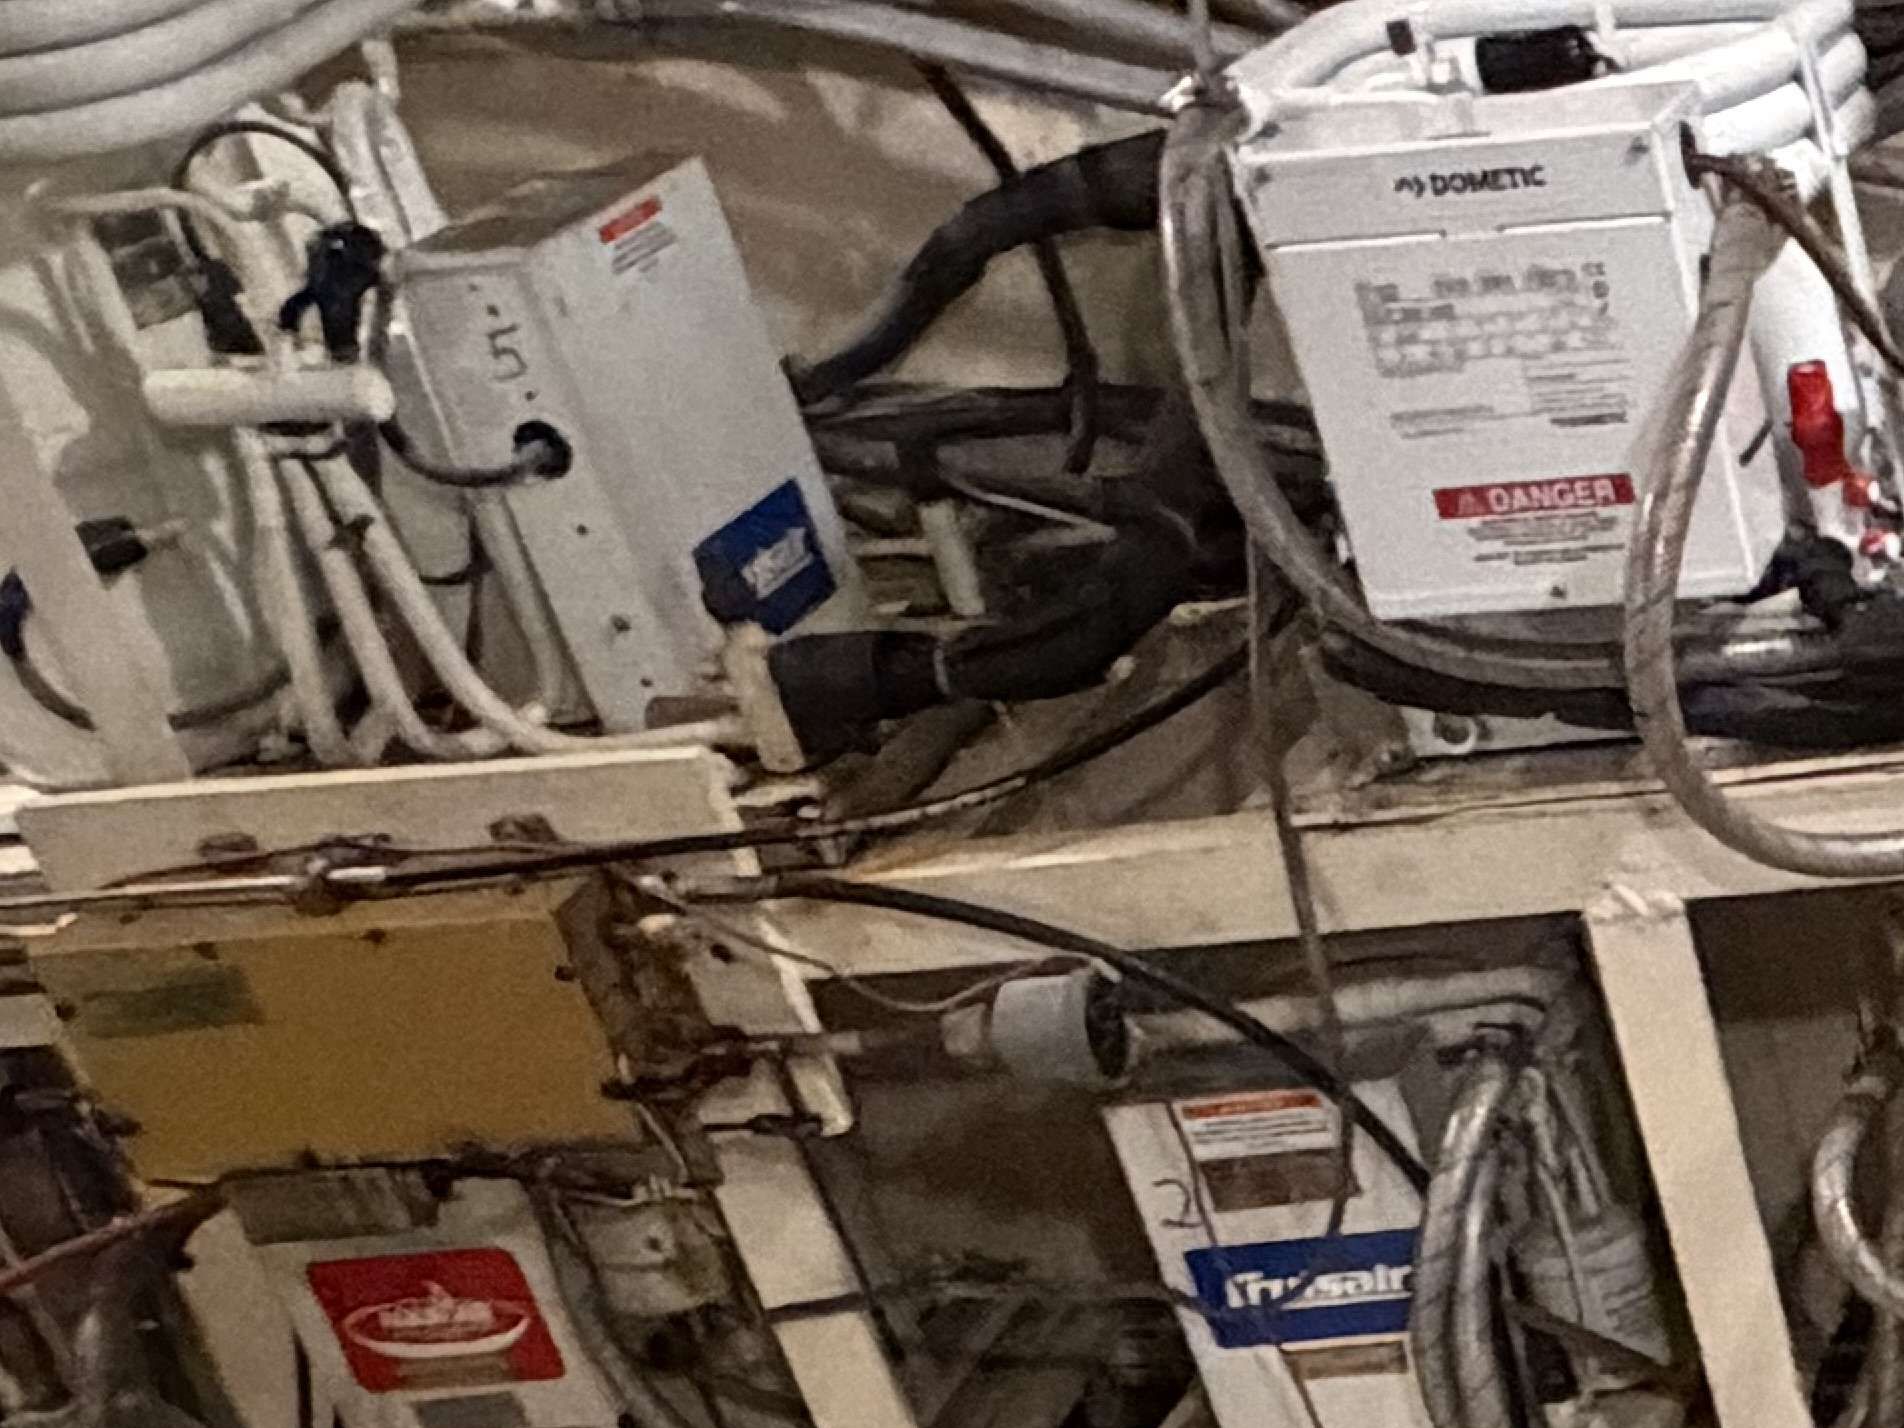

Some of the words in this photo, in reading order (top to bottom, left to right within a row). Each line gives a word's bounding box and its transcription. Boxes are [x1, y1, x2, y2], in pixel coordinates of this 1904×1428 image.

[1429, 164, 1547, 197] DOMETIC
[486, 322, 528, 381] 5
[1488, 478, 1618, 513] DANGER
[1151, 1177, 1203, 1228] 2
